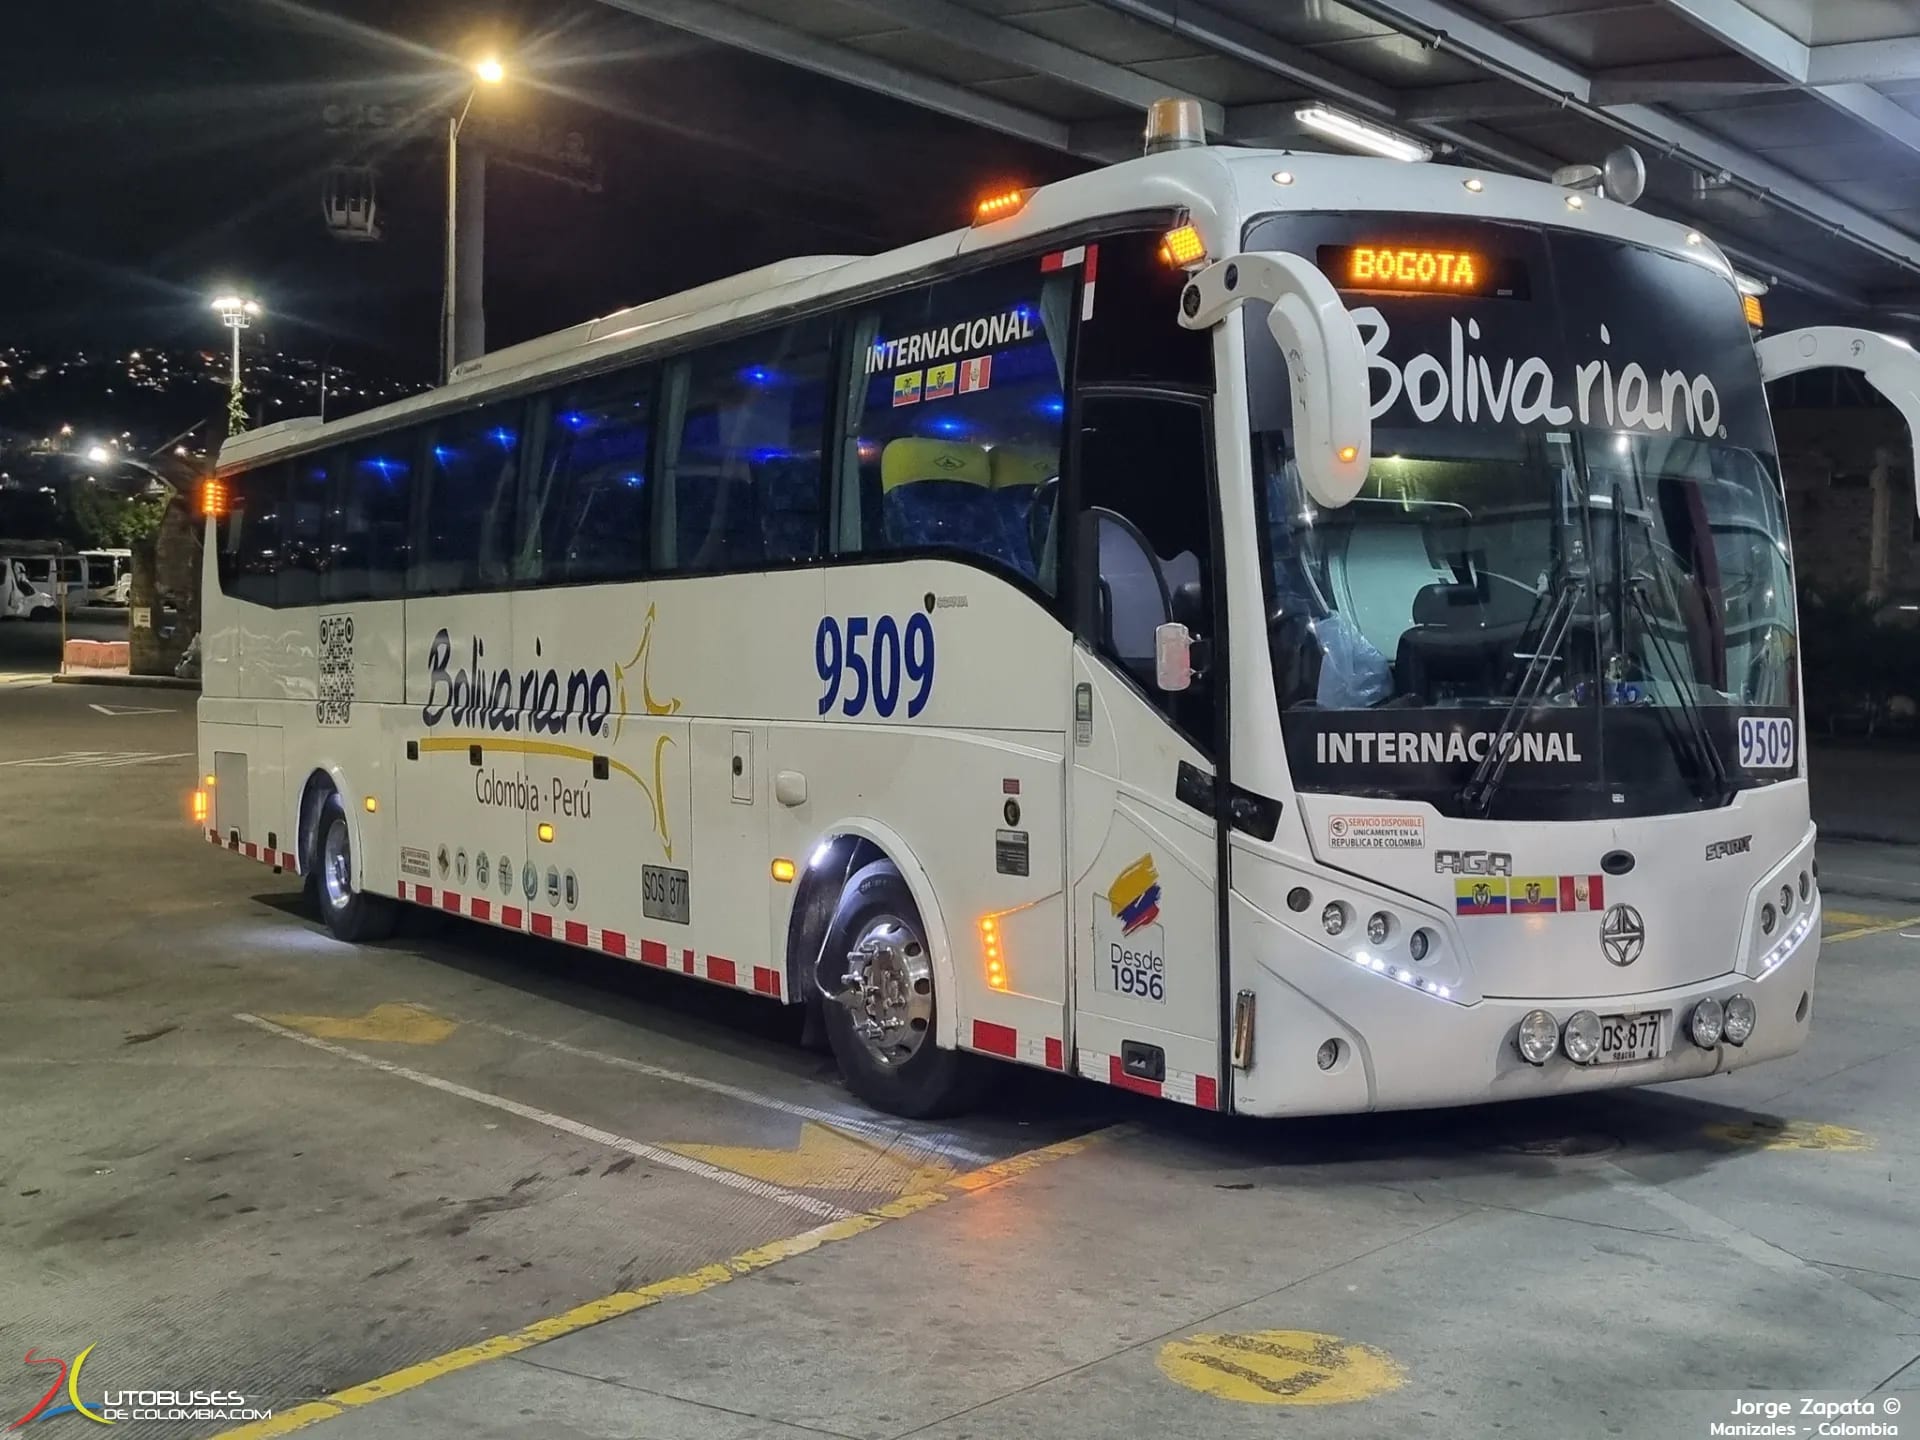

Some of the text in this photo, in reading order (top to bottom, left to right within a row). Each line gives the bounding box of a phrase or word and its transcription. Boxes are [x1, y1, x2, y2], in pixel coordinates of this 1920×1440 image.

[1353, 248, 1474, 286] BOGOTA
[864, 310, 1035, 375] INTERNACIONAL
[815, 612, 935, 719] 9509
[1740, 719, 1792, 766] 9509
[475, 767, 539, 812] Colombia
[552, 777, 591, 819] Perú
[1348, 818, 1422, 827] SERVICIO DISPONIBLE
[1331, 838, 1422, 847] REPUBLICA DE COLOMBIA
[1706, 835, 1753, 861] SPIRIT
[1435, 850, 1513, 876] AGA
[644, 871, 687, 905] SOS 877
[1111, 943, 1163, 973] Desde
[1111, 964, 1163, 1001] 1956
[1602, 1021, 1658, 1052] OS 877
